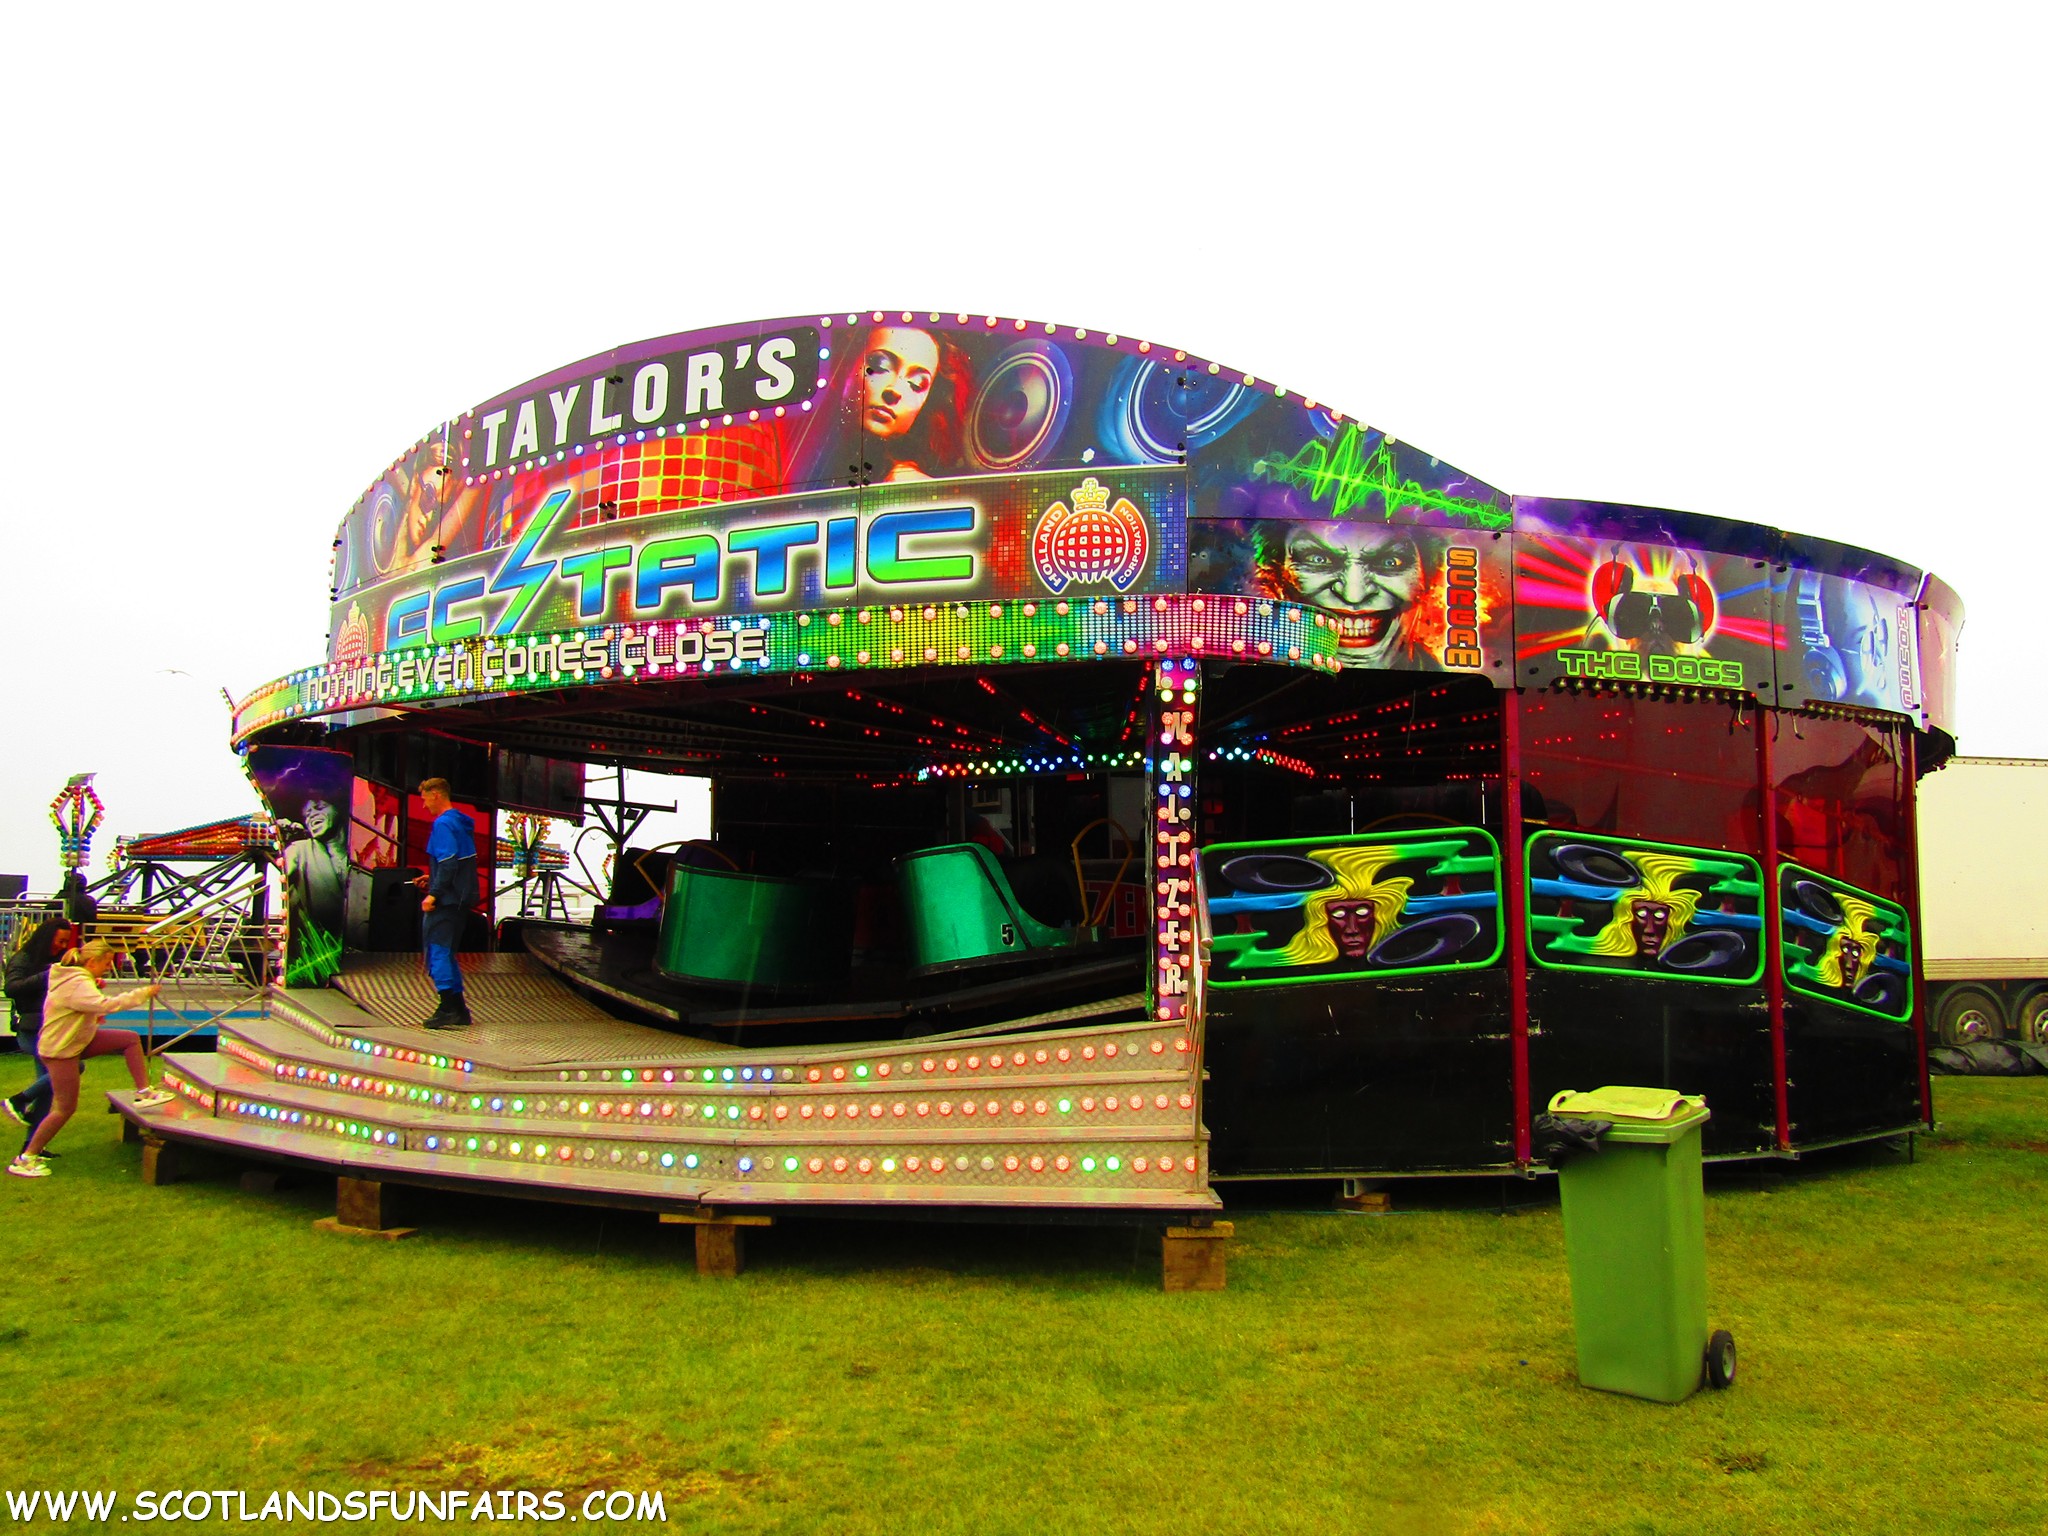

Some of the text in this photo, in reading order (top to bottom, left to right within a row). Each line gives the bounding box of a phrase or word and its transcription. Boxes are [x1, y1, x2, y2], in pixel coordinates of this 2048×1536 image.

[482, 337, 796, 467] TAYLOR'S
[1038, 509, 1062, 587] HOLLAND
[1117, 506, 1142, 584] CORPORATION
[1446, 547, 1482, 668] SCREAM
[307, 628, 765, 702] NOTHING EVEN COMES CLOSE
[1557, 649, 1744, 688] THE DOGS
[1896, 605, 1914, 710] HOUSE
[1163, 710, 1188, 995] WALTZER
[1001, 922, 1015, 947] 5
